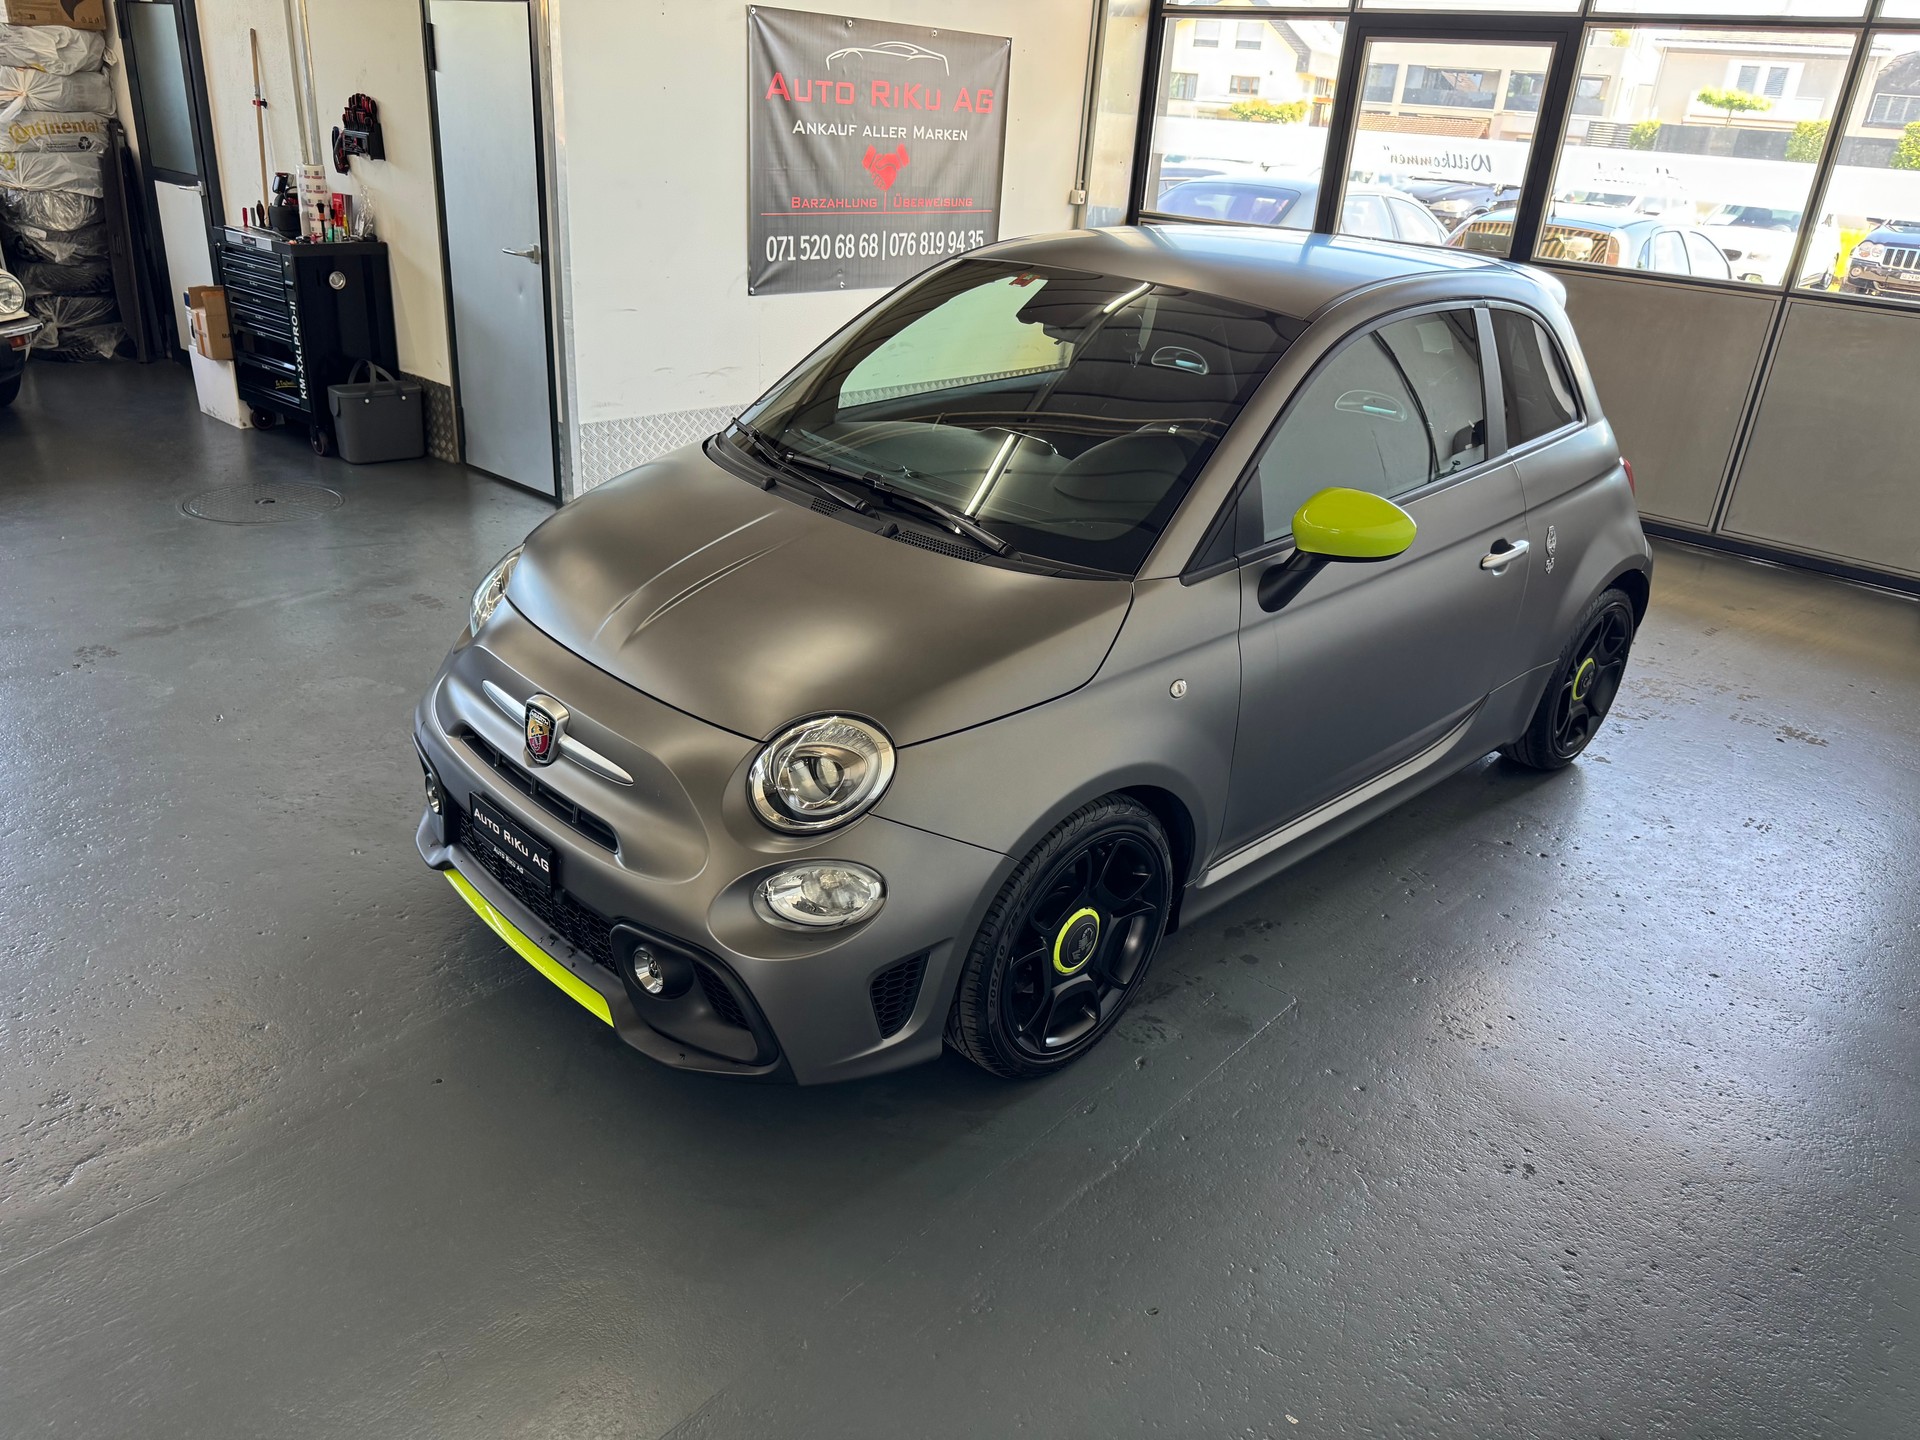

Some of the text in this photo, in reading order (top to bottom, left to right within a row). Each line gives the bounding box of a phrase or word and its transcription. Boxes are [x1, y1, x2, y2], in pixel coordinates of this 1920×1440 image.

[765, 72, 855, 105] AUTO
[953, 87, 993, 113] AG
[9, 119, 101, 144] Continental
[792, 119, 969, 141] ANKAUF ALLER MARKEN
[791, 192, 973, 209] BARZAHLUNG ÜBERWEISUNG
[766, 229, 984, 262] 071 520 68 68 076 819 94 35
[474, 808, 500, 835] AUTO
[532, 853, 549, 873] AG
